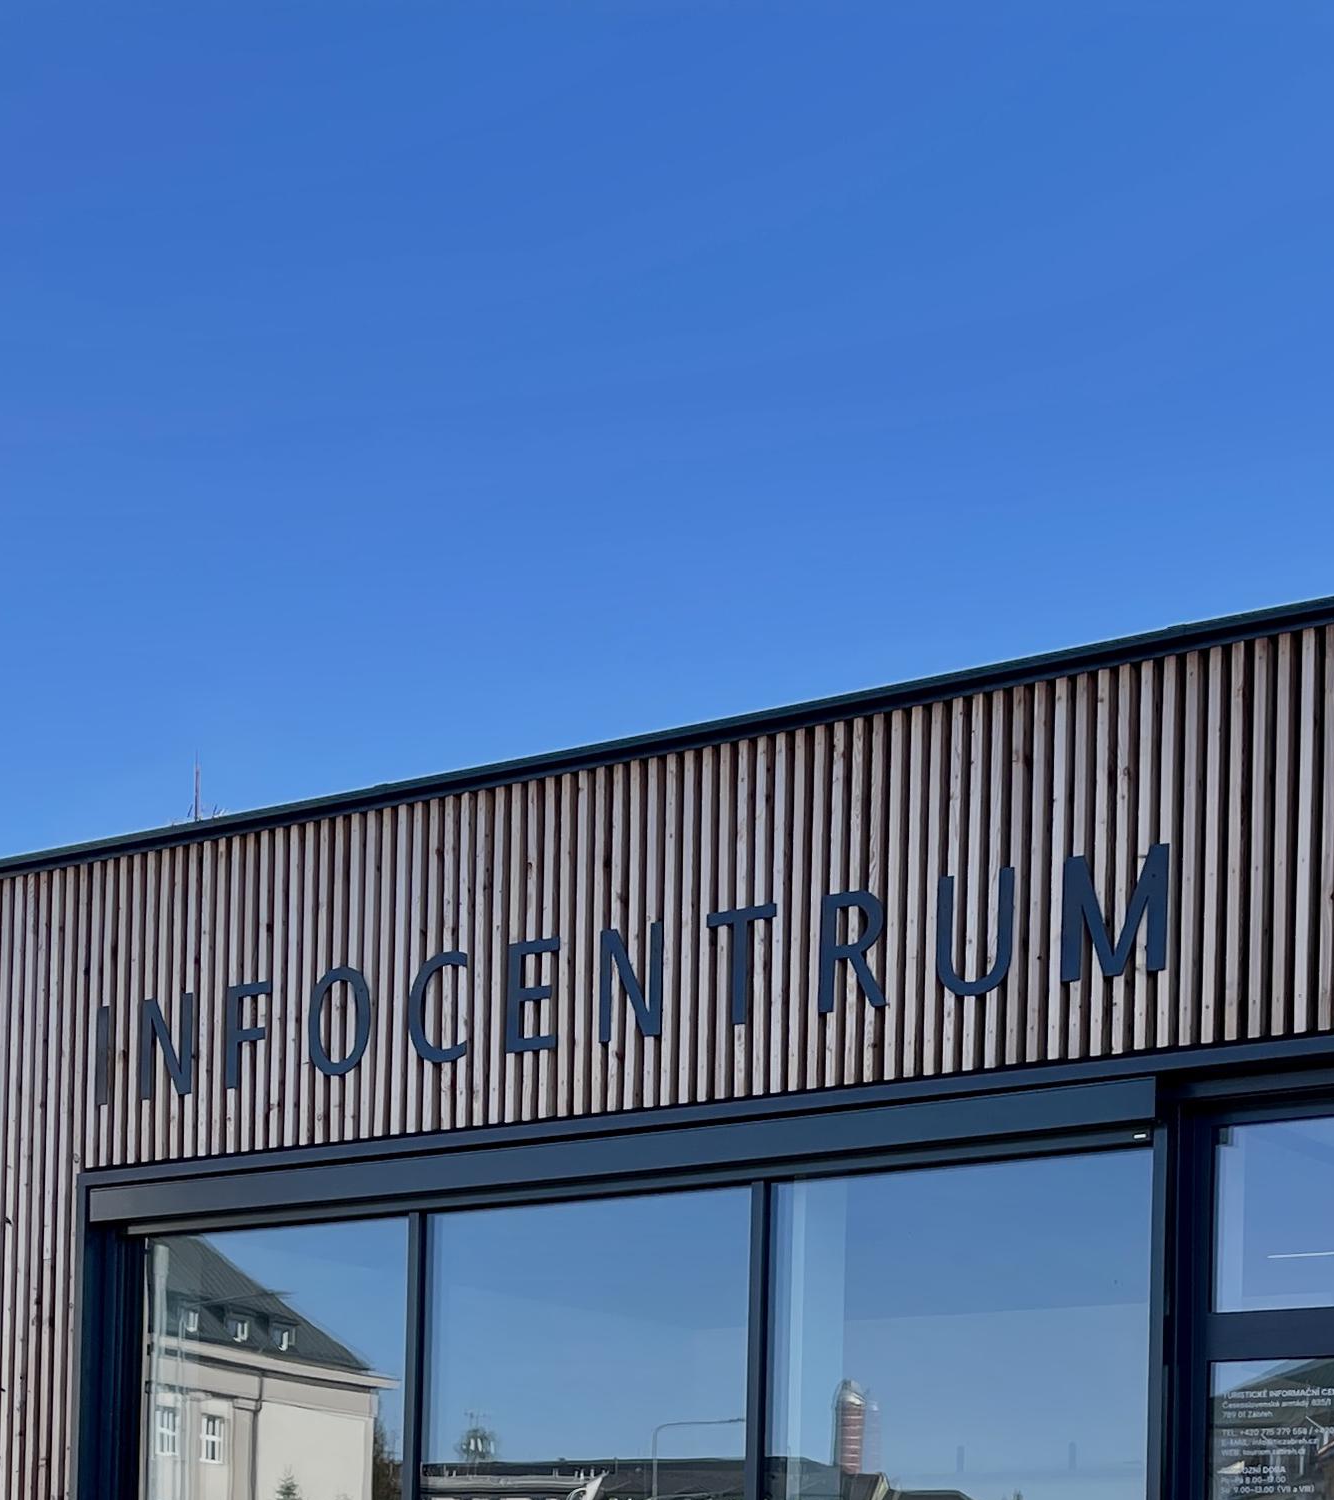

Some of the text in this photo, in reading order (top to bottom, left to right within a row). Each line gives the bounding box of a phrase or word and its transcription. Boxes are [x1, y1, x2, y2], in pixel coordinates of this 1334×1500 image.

[94, 843, 1170, 1106] INFOCENTRUM
[1223, 1389, 1267, 1399] TURISTICKÉ
[1269, 1386, 1320, 1398] INFORMAČNÍ
[1240, 1428, 1259, 1436] +420
[1263, 1465, 1286, 1474] DOBA
